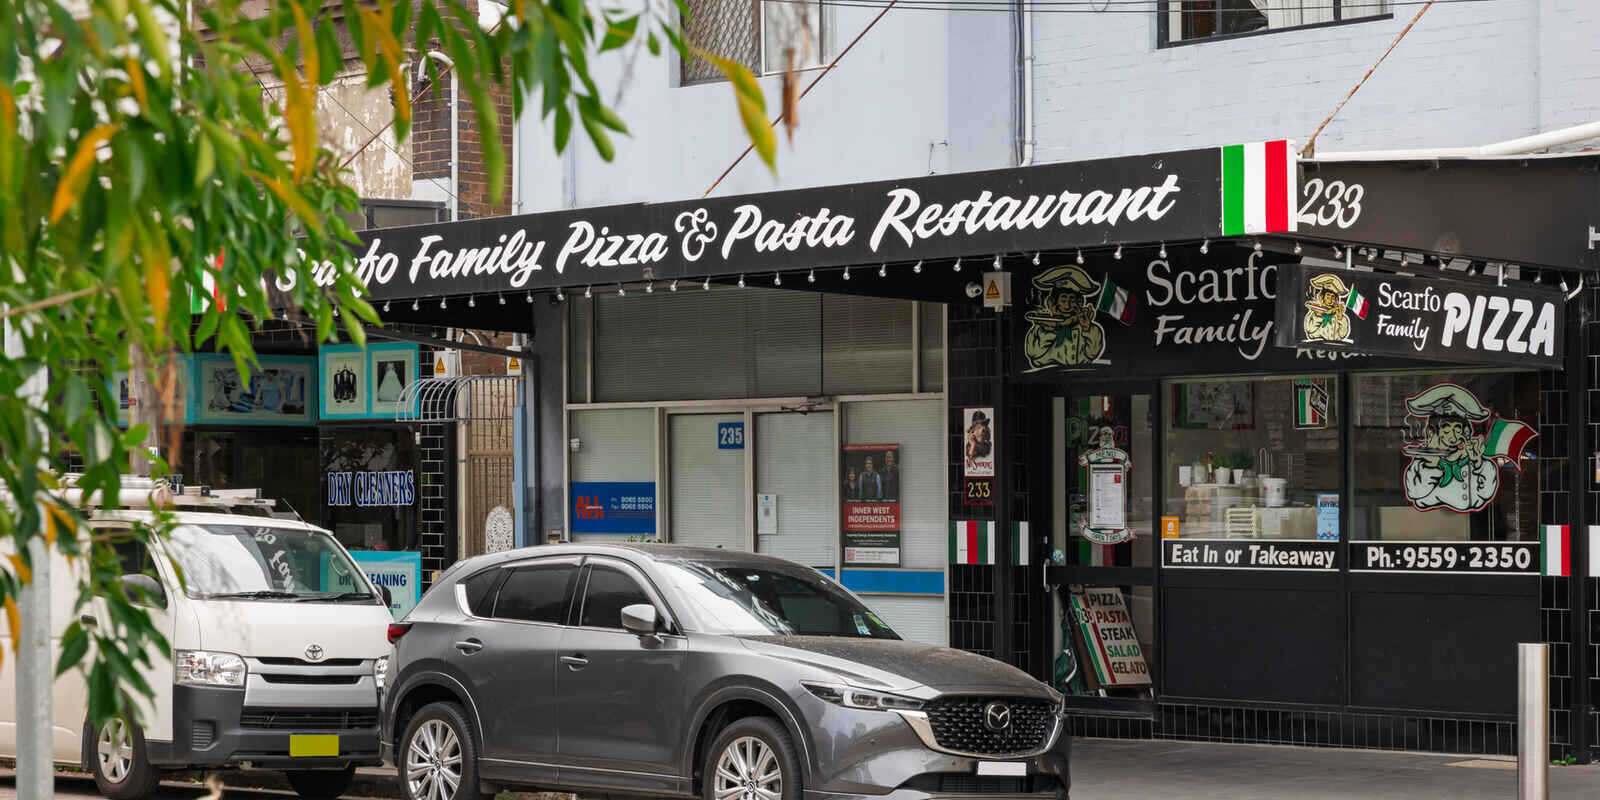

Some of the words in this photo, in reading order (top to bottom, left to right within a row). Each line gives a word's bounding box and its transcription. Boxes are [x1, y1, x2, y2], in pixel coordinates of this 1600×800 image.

[1298, 178, 1364, 230] 233
[409, 228, 546, 288] Family
[556, 220, 668, 274] Pizza
[674, 207, 718, 262] &
[722, 204, 855, 260] Pasta
[870, 174, 1180, 252] Restaurant
[1378, 282, 1441, 315] Scarfo
[1377, 314, 1431, 352] Family
[1441, 291, 1555, 358] PIZZA
[1154, 309, 1274, 361] Family
[720, 427, 743, 446] 235
[328, 472, 352, 506] DRY
[355, 470, 415, 507] CLEANERS
[967, 482, 991, 498] 233
[575, 495, 600, 510] ALL
[872, 506, 890, 514] WEST
[848, 515, 895, 523] INDEPENDENTS
[1171, 543, 1198, 563] Eat
[1203, 544, 1218, 563] In
[1225, 548, 1242, 564] or
[1249, 544, 1335, 569] Takeaway
[1089, 593, 1122, 606] PIZZA
[1095, 609, 1129, 624] PASTA
[1100, 627, 1136, 641] STEAK
[1106, 644, 1141, 658] SALAD
[1111, 661, 1147, 674] GELATO
